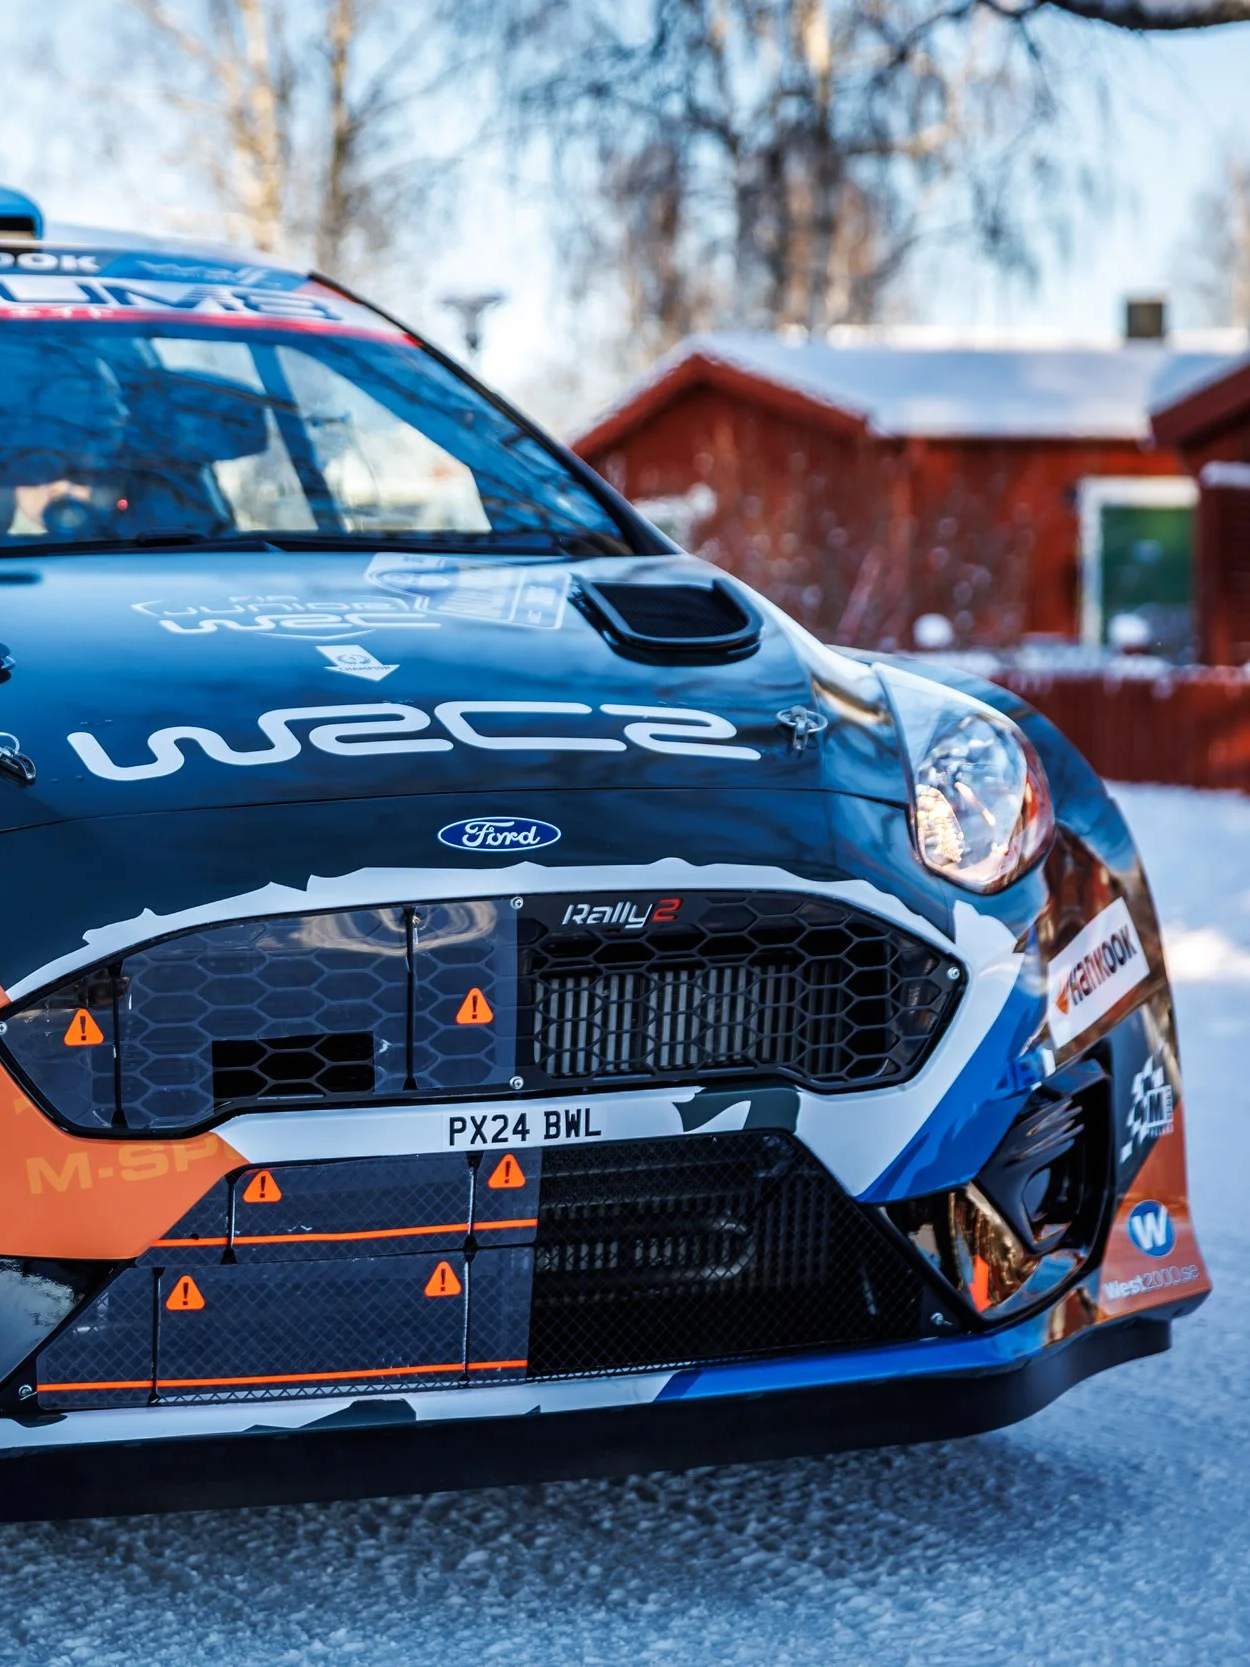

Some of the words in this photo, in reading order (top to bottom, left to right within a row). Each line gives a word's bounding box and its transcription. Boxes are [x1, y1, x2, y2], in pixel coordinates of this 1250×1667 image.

[158, 613, 442, 634] WRC
[66, 702, 761, 781] WRC2
[462, 821, 541, 848] Ford
[562, 898, 683, 929] Rally2
[449, 1113, 530, 1146] PX24
[544, 1107, 602, 1140] BWL
[1131, 1205, 1169, 1250] W
[1103, 1264, 1200, 1300] West2000.se
